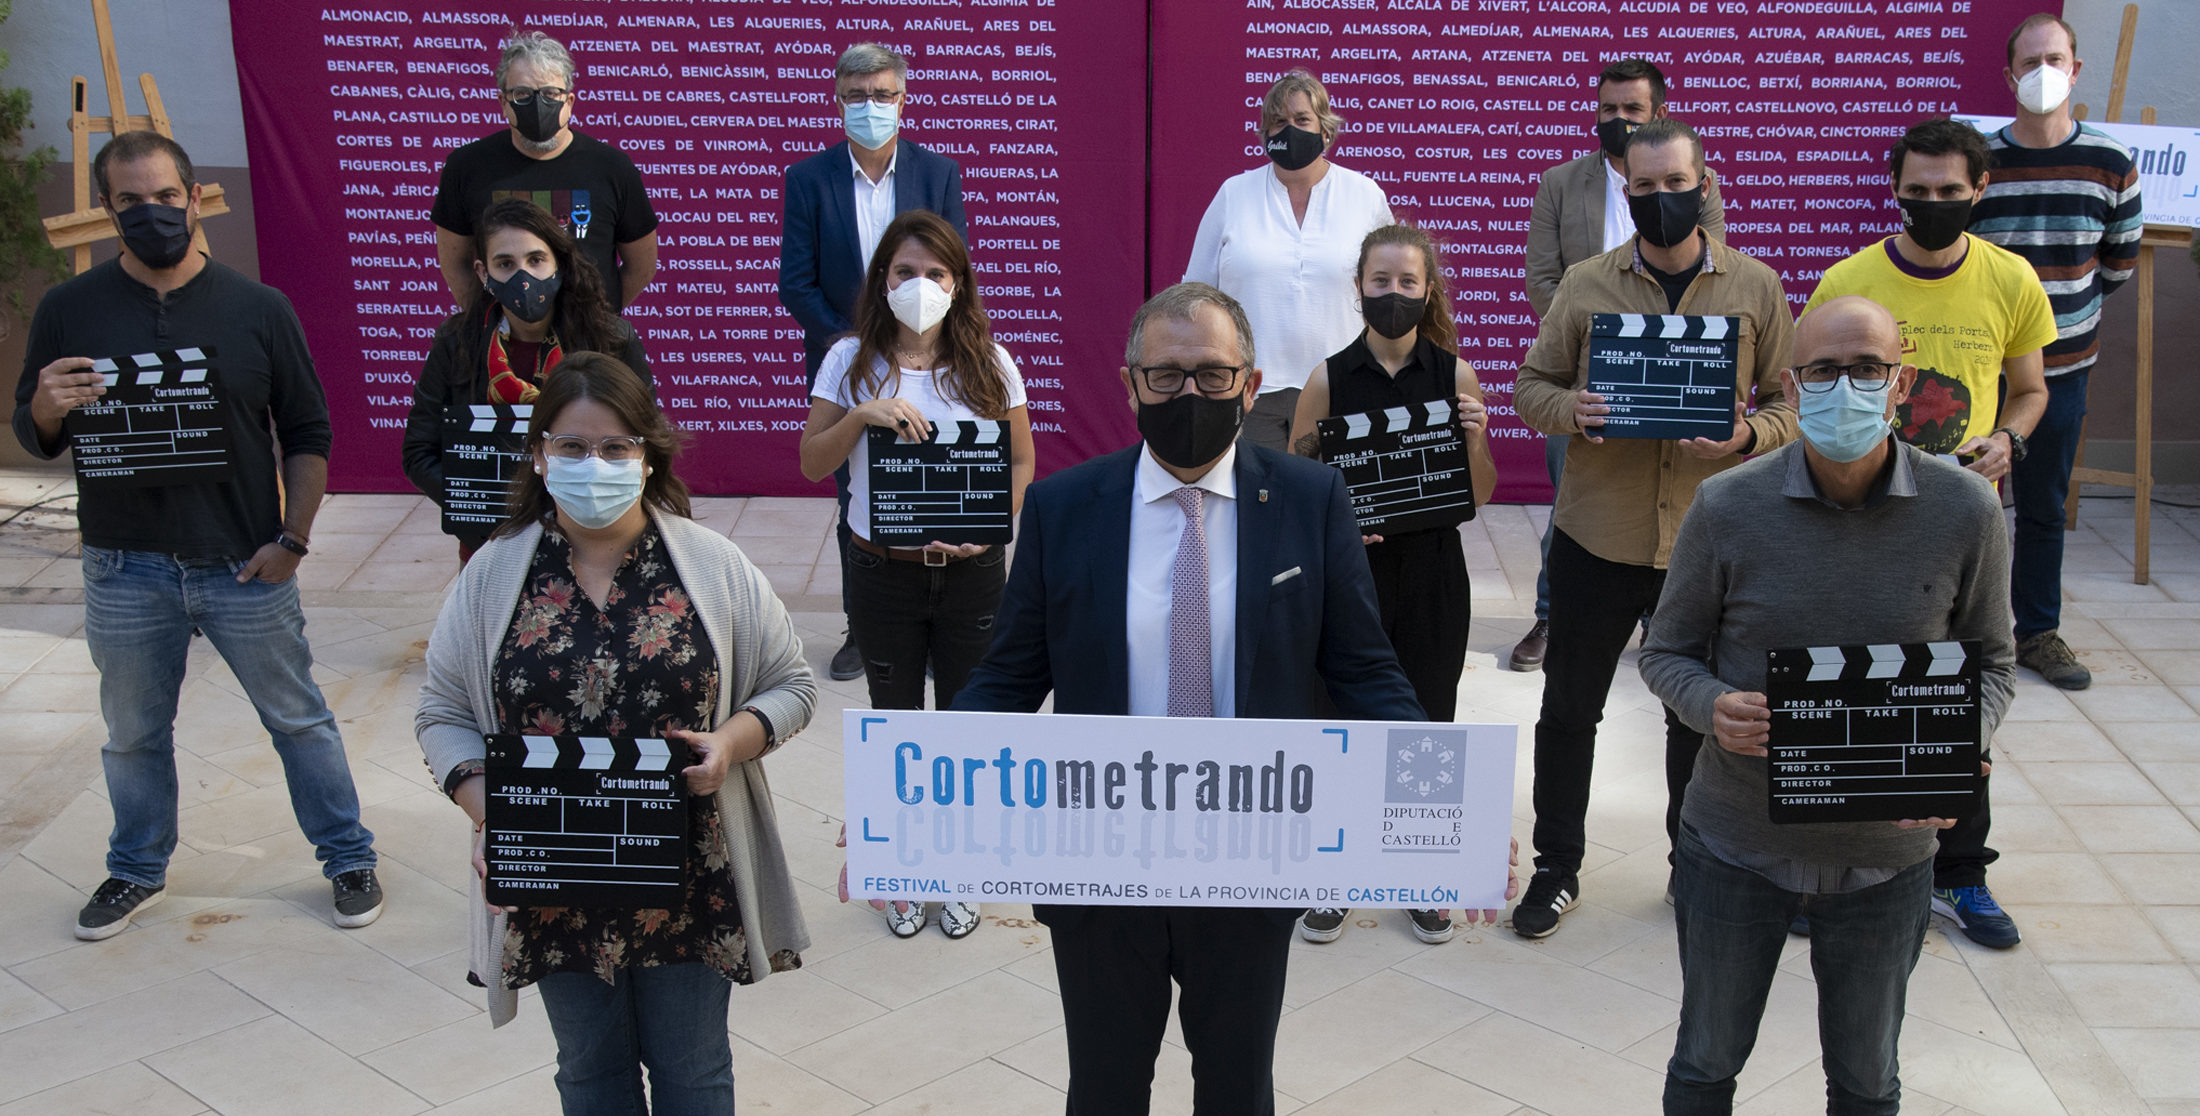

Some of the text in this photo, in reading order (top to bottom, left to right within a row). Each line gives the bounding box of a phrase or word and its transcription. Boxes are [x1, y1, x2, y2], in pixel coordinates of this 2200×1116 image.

[1478, 0, 1943, 14] XIVERT, L'ALCORA, ALCUDIA VEO, ALFONDEGUILLA, ALGIMIA
[322, 10, 973, 32] ALMONACID, ALMASSORA, ALMEDÍJAR, ALMENARA, ALQUERIES, ALTURA, ARAÑUEL,
[1658, 25, 1885, 40] ALQUERIES, ARAÑUEL,
[324, 35, 1056, 58] MAESTRAT, ARGELITA, ATZENETA AYÓDAR, BARRACAS, BEJÍS,
[1412, 49, 1824, 64] ARTANA, AZUÉBAR,
[328, 61, 1056, 82] BENAFER, BENAFIGOS, BENICARLÓ, BENICÀSSIM, BORRIANA, BORRIOL,
[1414, 74, 1802, 89] BENASSAL, BENLLOC, BETXÍ,
[331, 85, 1011, 105] CABANES, CÀLIG, CASTELLFORT, CASTELLÓ
[1368, 98, 1837, 114] CANET ROIG, CASTELLNOVO,
[334, 111, 1057, 131] PLANA, CATÍ, CAUDIEL, CINCTORRES, CIRAT,
[1388, 123, 1816, 138] VILLAMALEFA, CHÓVAR,
[337, 136, 1058, 155] CORTES VINROMÀ, CULLA FANZARA,
[1336, 146, 1873, 163] ARENOSO, COSTUR, ESLIDA, ESPADILLA,
[340, 160, 1038, 179] FIGUEROLES, AYÓDAR, HIGUERAS,
[1404, 172, 1853, 187] FUENTE REINA, GELDO, HERBERS,
[344, 183, 1059, 204] JANA, JÉRICA MONTÁN,
[1430, 196, 1875, 211] LLUCENA, MATET, MONCOFA,
[750, 213, 1059, 227] REY, PALANQUES,
[1418, 220, 1852, 234] NAVAJAS, MAR,
[349, 231, 1038, 249] PAVÍAS, POBLA PORTELL
[352, 257, 1061, 274] MORELLA, ROSSELL, RÍO,
[354, 280, 726, 295] SANT MATEU,
[1456, 291, 1499, 302] JORDI,
[357, 304, 771, 318] SERRATELLA, FERRER,
[1480, 314, 1536, 326] SONEJA,
[360, 327, 1063, 344] TOGA, PINAR, DOMÉNEC,
[1900, 325, 1925, 336] plec
[1670, 344, 1722, 355] Cortometrando
[692, 353, 1063, 365] USERES, VALL
[365, 372, 761, 386] D'UIXÓ, VILAFRANCA,
[155, 386, 210, 398] Cortometrando
[705, 396, 731, 409] RÍO,
[678, 421, 767, 432] XERT, XILXES,
[1490, 428, 1531, 439] VIVER,
[175, 431, 208, 439] SOUND
[1402, 428, 1452, 444] Cortometrando
[950, 449, 999, 459] Cortometrando
[1389, 452, 1413, 461] TAKE
[1422, 472, 1452, 483] SOUND
[1891, 682, 1966, 697] Cortometrando
[1791, 707, 1966, 720] SCENE TAKE ROLL
[1780, 746, 1953, 758] DATE SOUND
[601, 776, 670, 791] Cortometrando
[895, 742, 1313, 813] Cortometrando
[1780, 779, 1832, 788] DIRECTOR
[509, 796, 675, 810] SCENE TAKE ROLL
[1781, 797, 1845, 805] CAMERAMAN
[1384, 807, 1462, 819] DIPUTACIÓ
[497, 834, 662, 847] DATE SOUND
[1382, 833, 1460, 845] CASTELLÓ
[497, 863, 547, 873] DIRECTOR
[498, 880, 561, 890] CAMERAMAN
[865, 878, 1458, 902] FESTIVAL DE CORTOMETRAJES DE LA PROVINCIA DE CASTELLÓN
